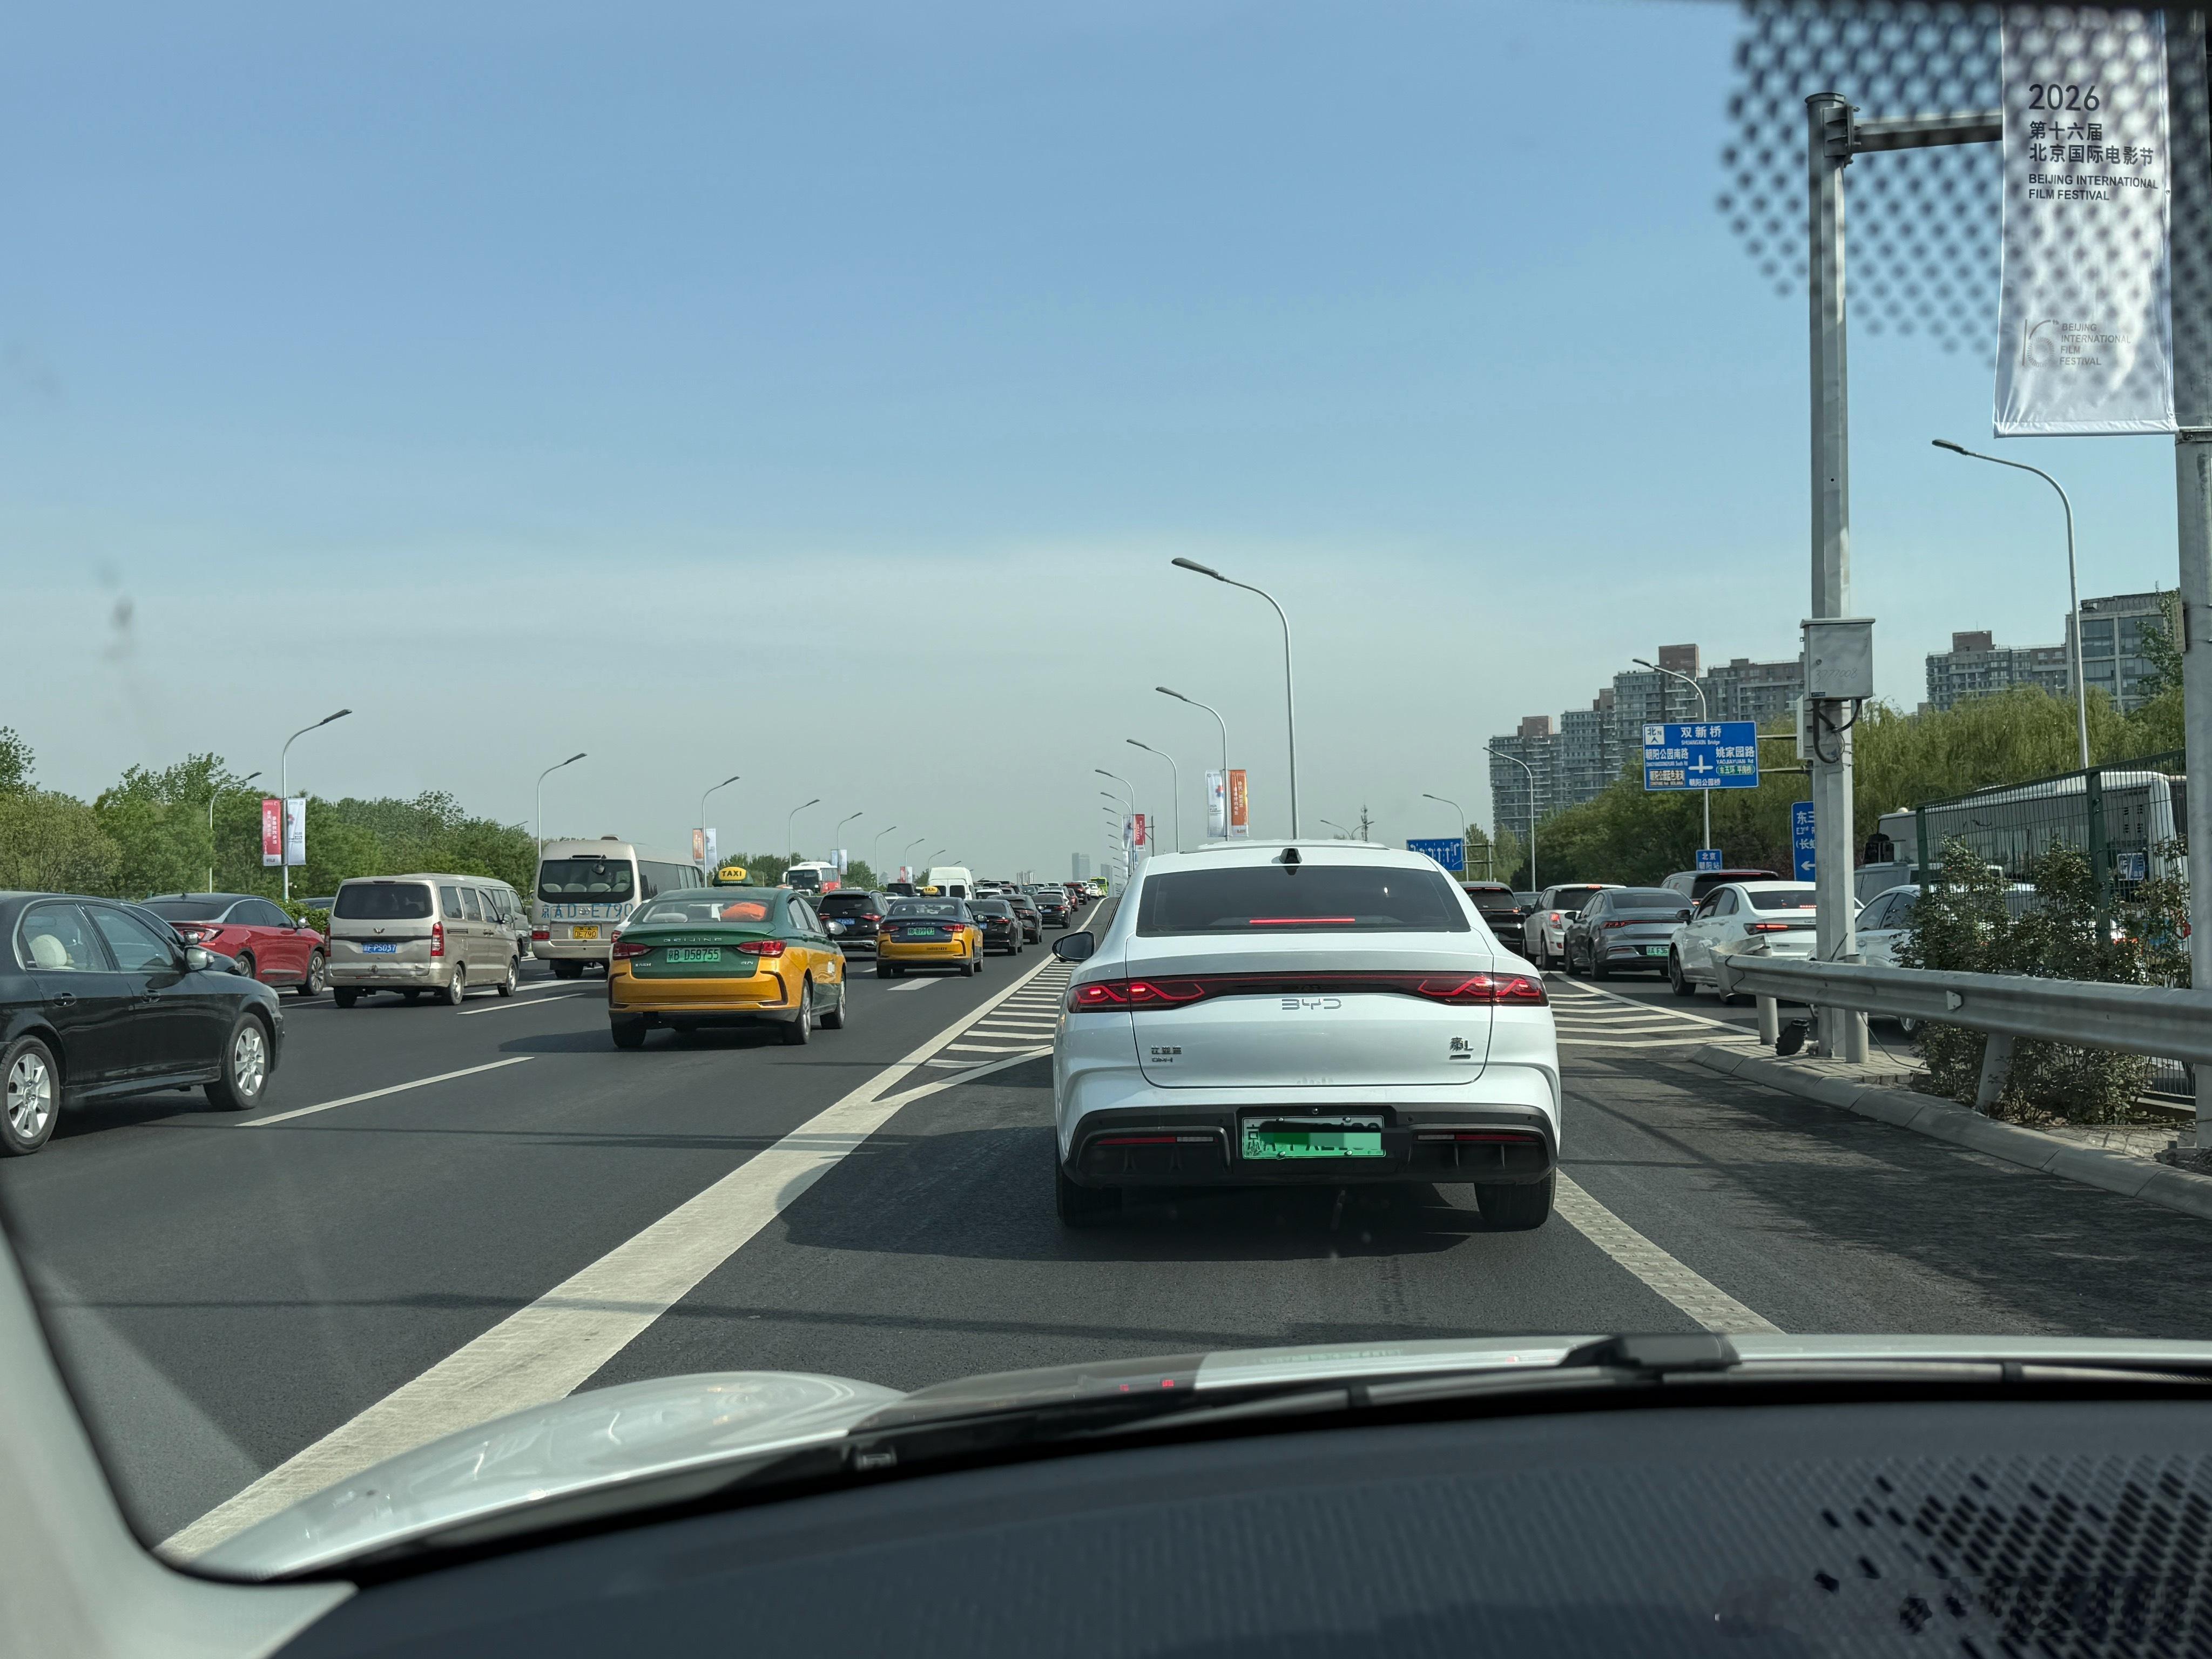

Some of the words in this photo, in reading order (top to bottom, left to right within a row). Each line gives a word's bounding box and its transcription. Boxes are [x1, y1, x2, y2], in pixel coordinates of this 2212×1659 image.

[2028, 84, 2100, 111] 2026
[2029, 121, 2102, 141] 第十六届
[2029, 143, 2154, 166] 北京国际电影节
[2028, 174, 2073, 185] BEIJING
[2076, 176, 2159, 189] INTERNATIONAL
[2028, 189, 2054, 199] FILM
[2058, 190, 2109, 200] FESTIVAL
[2061, 323, 2096, 332] BEIJING
[2061, 334, 2131, 343] INTERNATIONAL
[2060, 346, 2080, 354] FILM
[2060, 357, 2102, 366] FESTIVAL
[1647, 727, 1656, 736] 北
[1680, 726, 1722, 738] 双新桥
[1645, 748, 1689, 760] 朝阳公园南路
[1716, 746, 1755, 758] 姚家园路
[684, 949, 720, 961] D58755
[1282, 999, 1342, 1010] BYD
